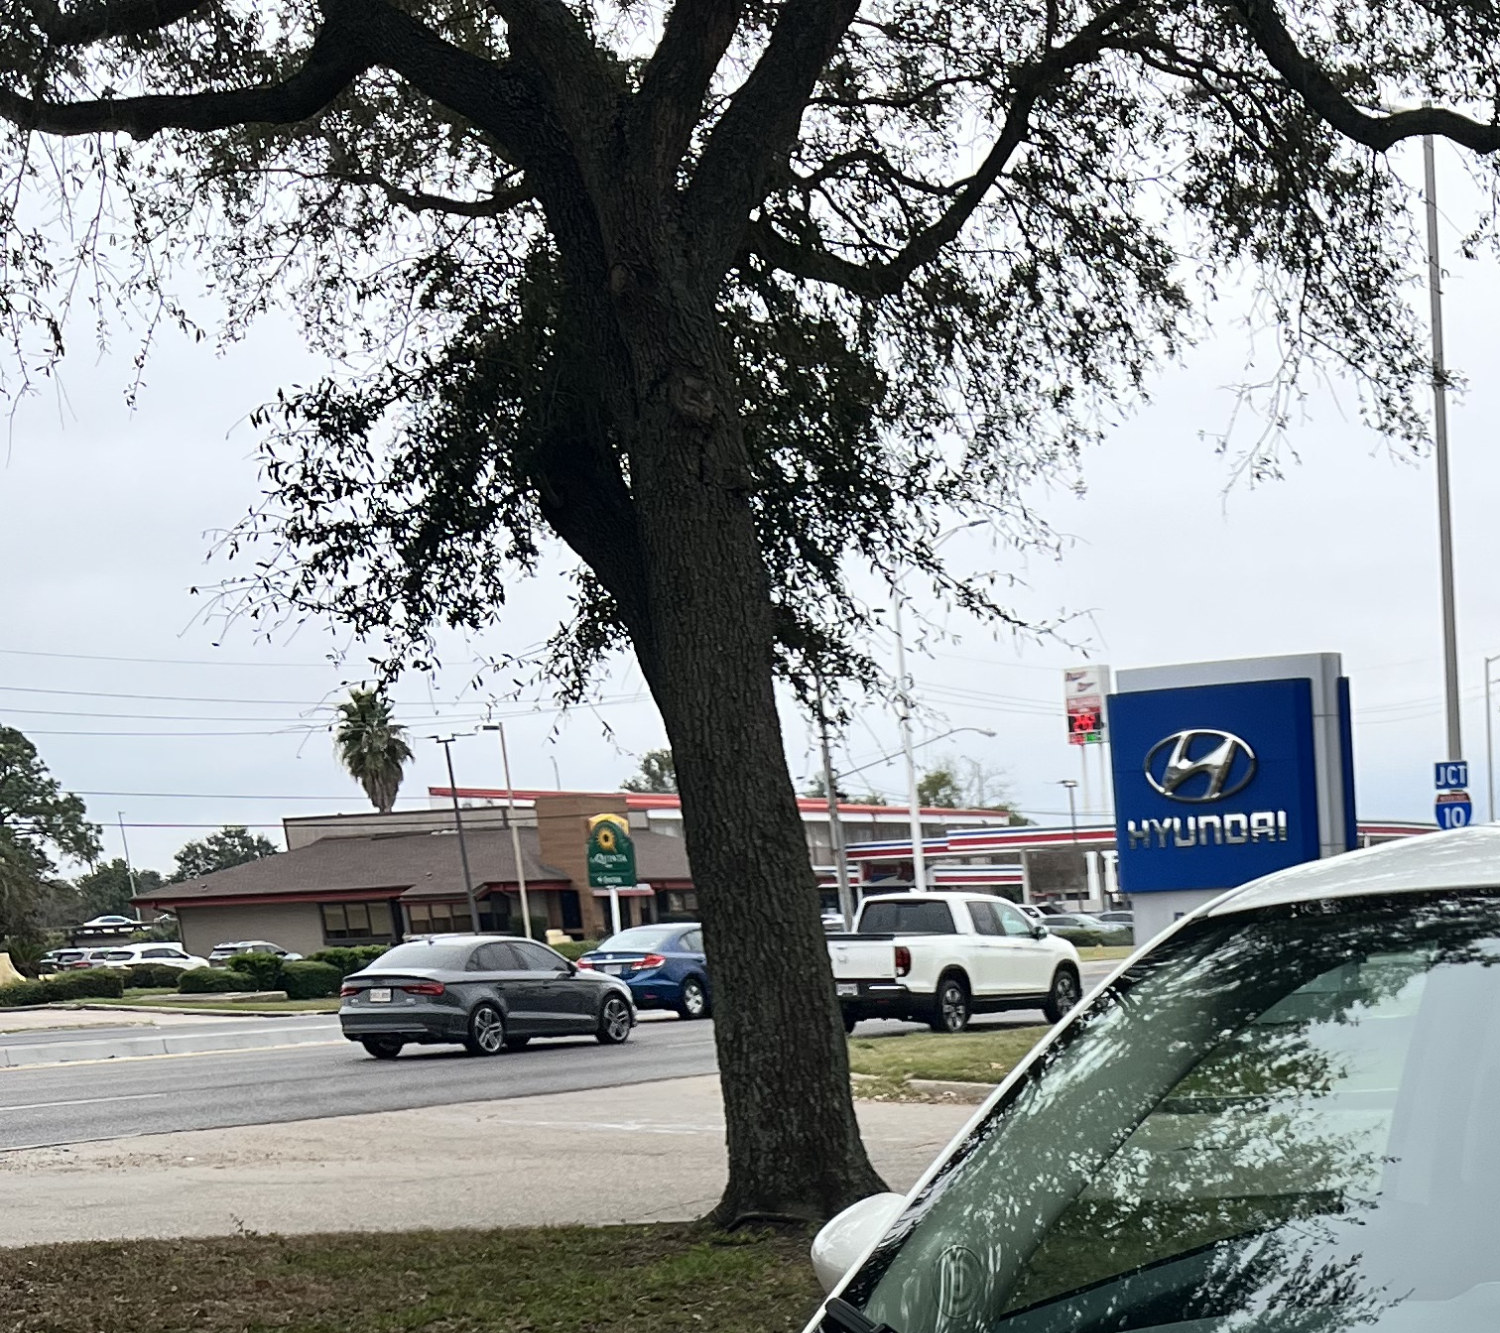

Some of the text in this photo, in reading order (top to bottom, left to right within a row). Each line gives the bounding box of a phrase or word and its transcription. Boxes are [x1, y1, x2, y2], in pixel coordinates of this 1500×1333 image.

[1436, 765, 1467, 786] JCT
[1127, 809, 1288, 849] HYUNDAI
[1443, 806, 1467, 829] 10
